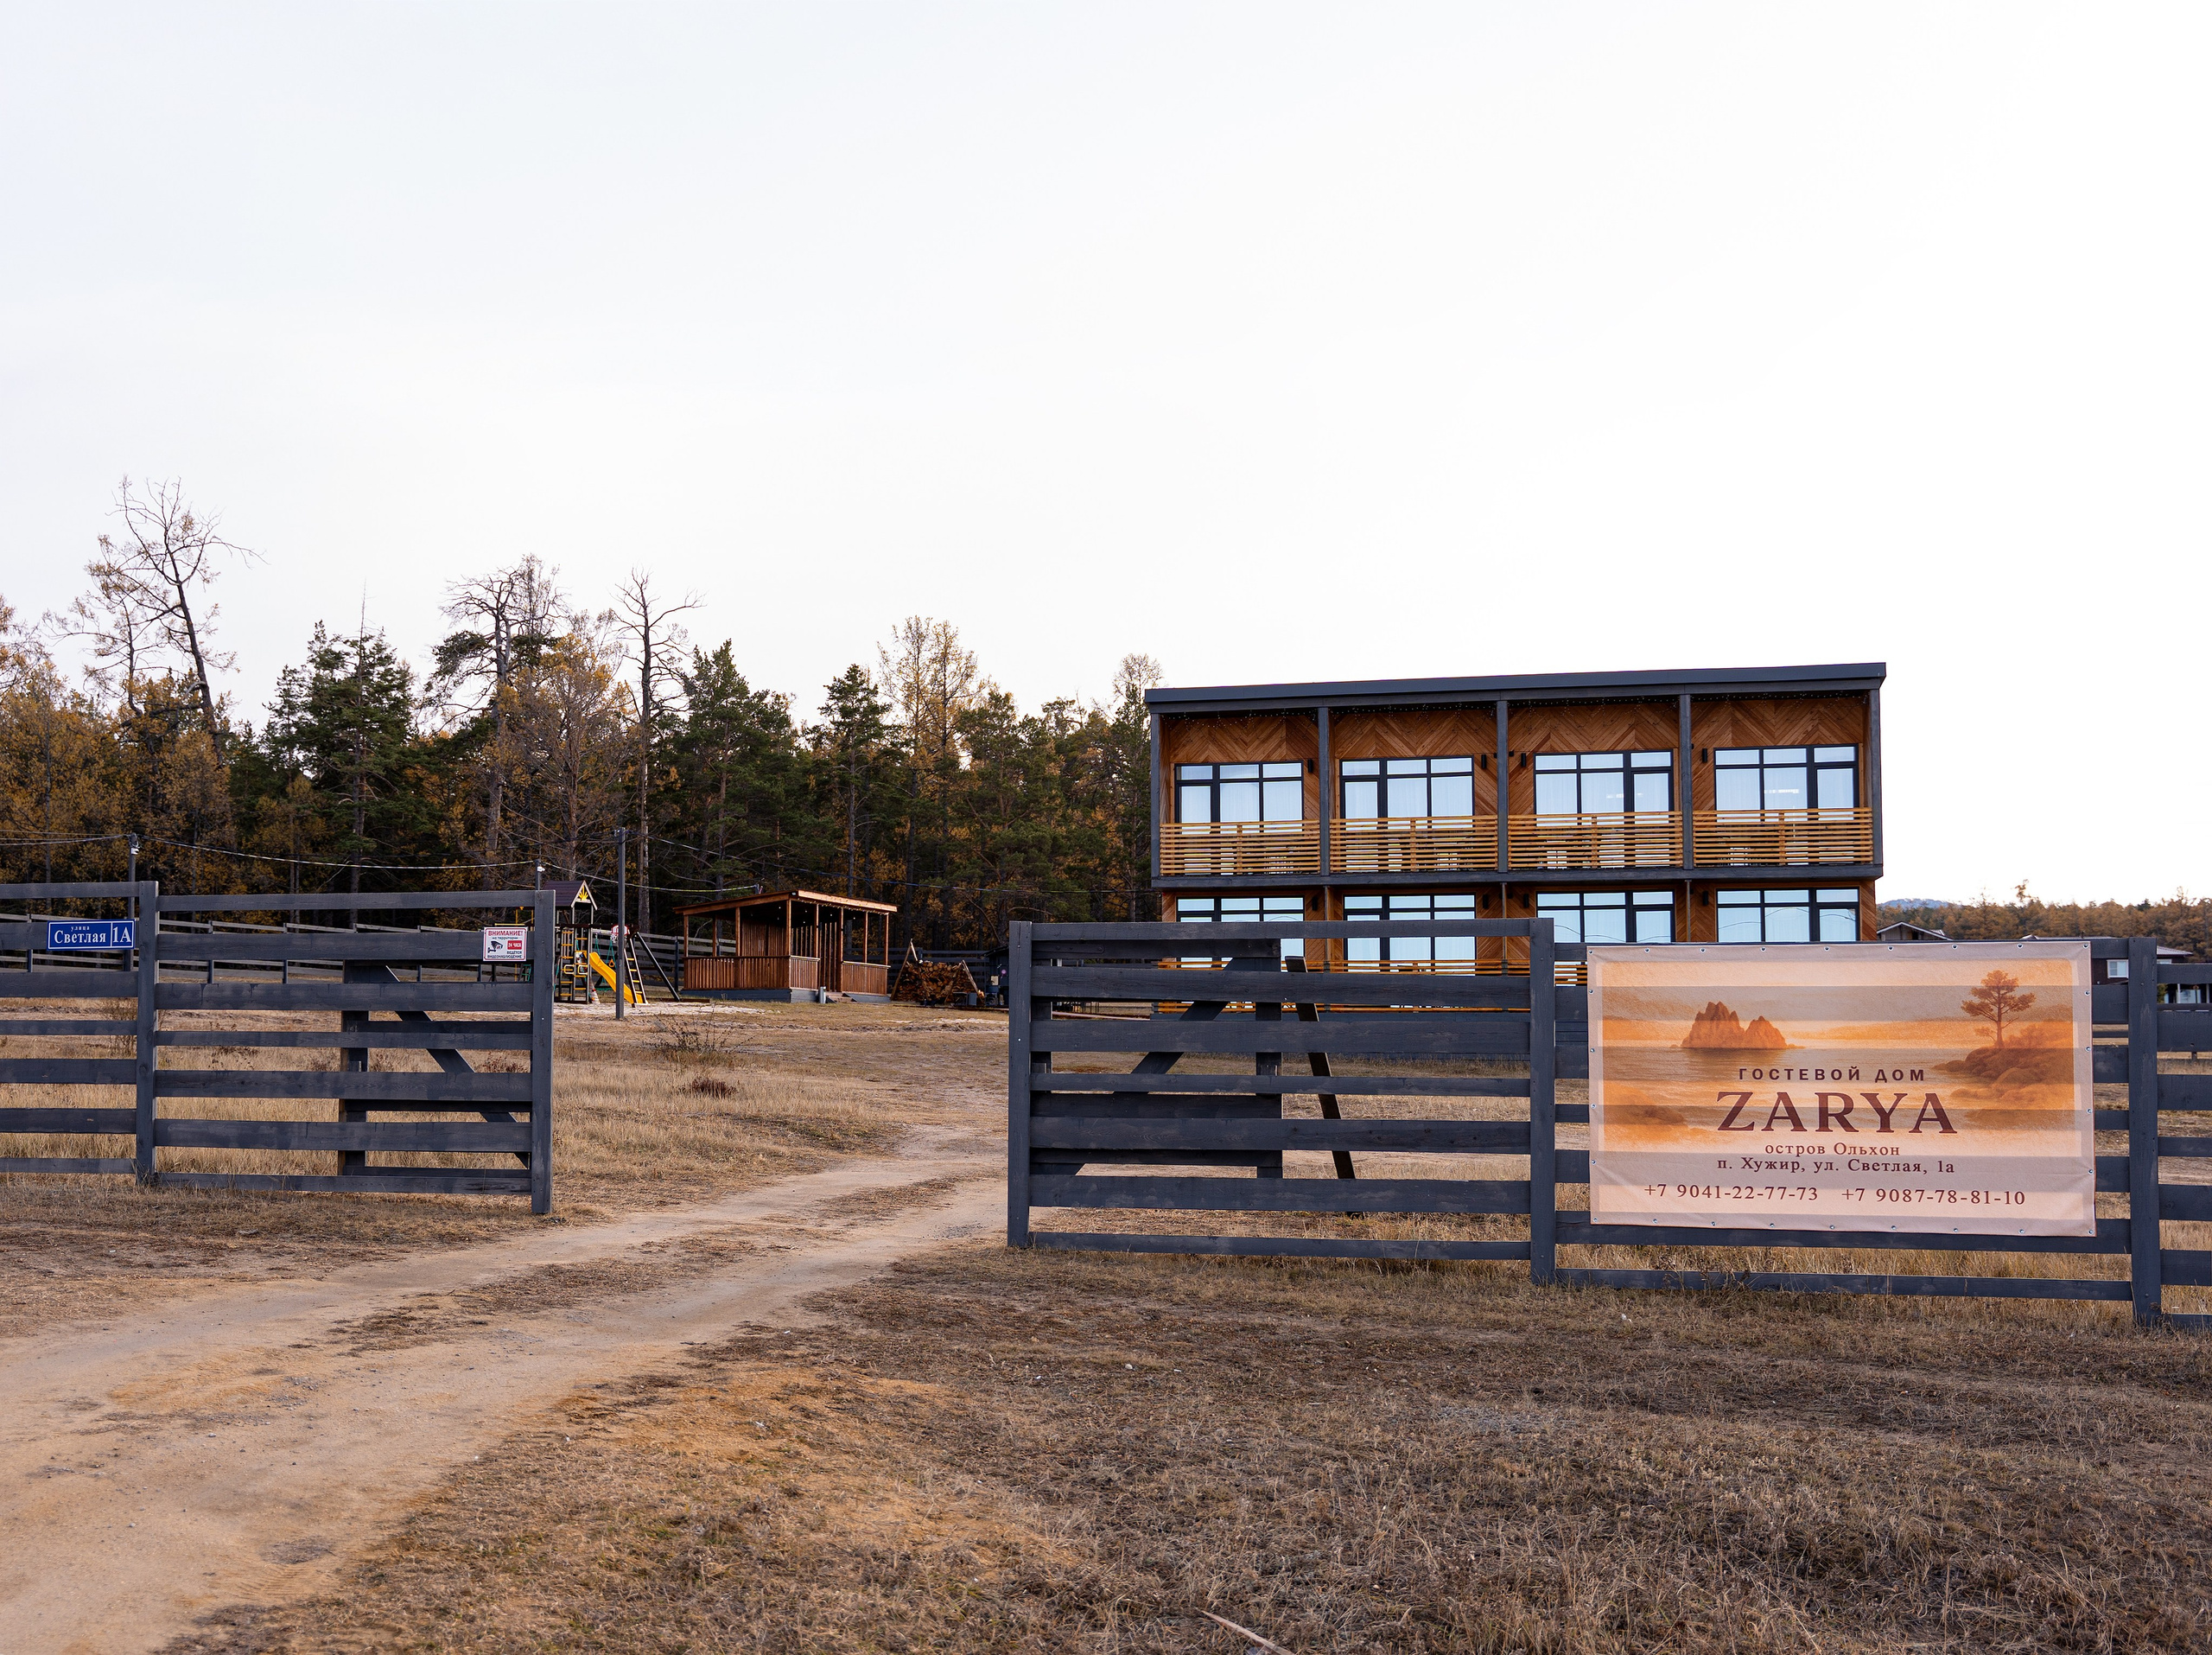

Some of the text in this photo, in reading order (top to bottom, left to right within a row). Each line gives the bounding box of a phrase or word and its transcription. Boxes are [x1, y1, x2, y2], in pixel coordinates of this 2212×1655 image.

[54, 930, 106, 944] Светлая
[113, 926, 131, 943] 1А
[1738, 1066, 1925, 1084] ГОСТЕВОЙ ДОМ
[1716, 1091, 1959, 1134] ZARYA
[1764, 1142, 1901, 1157] остров Ольхон
[1717, 1156, 1956, 1175] п. Хужир, ул. Светлая, 1а
[1643, 1183, 2026, 1206] +7 9041-22-77-73 +7 9087-78-81-10
